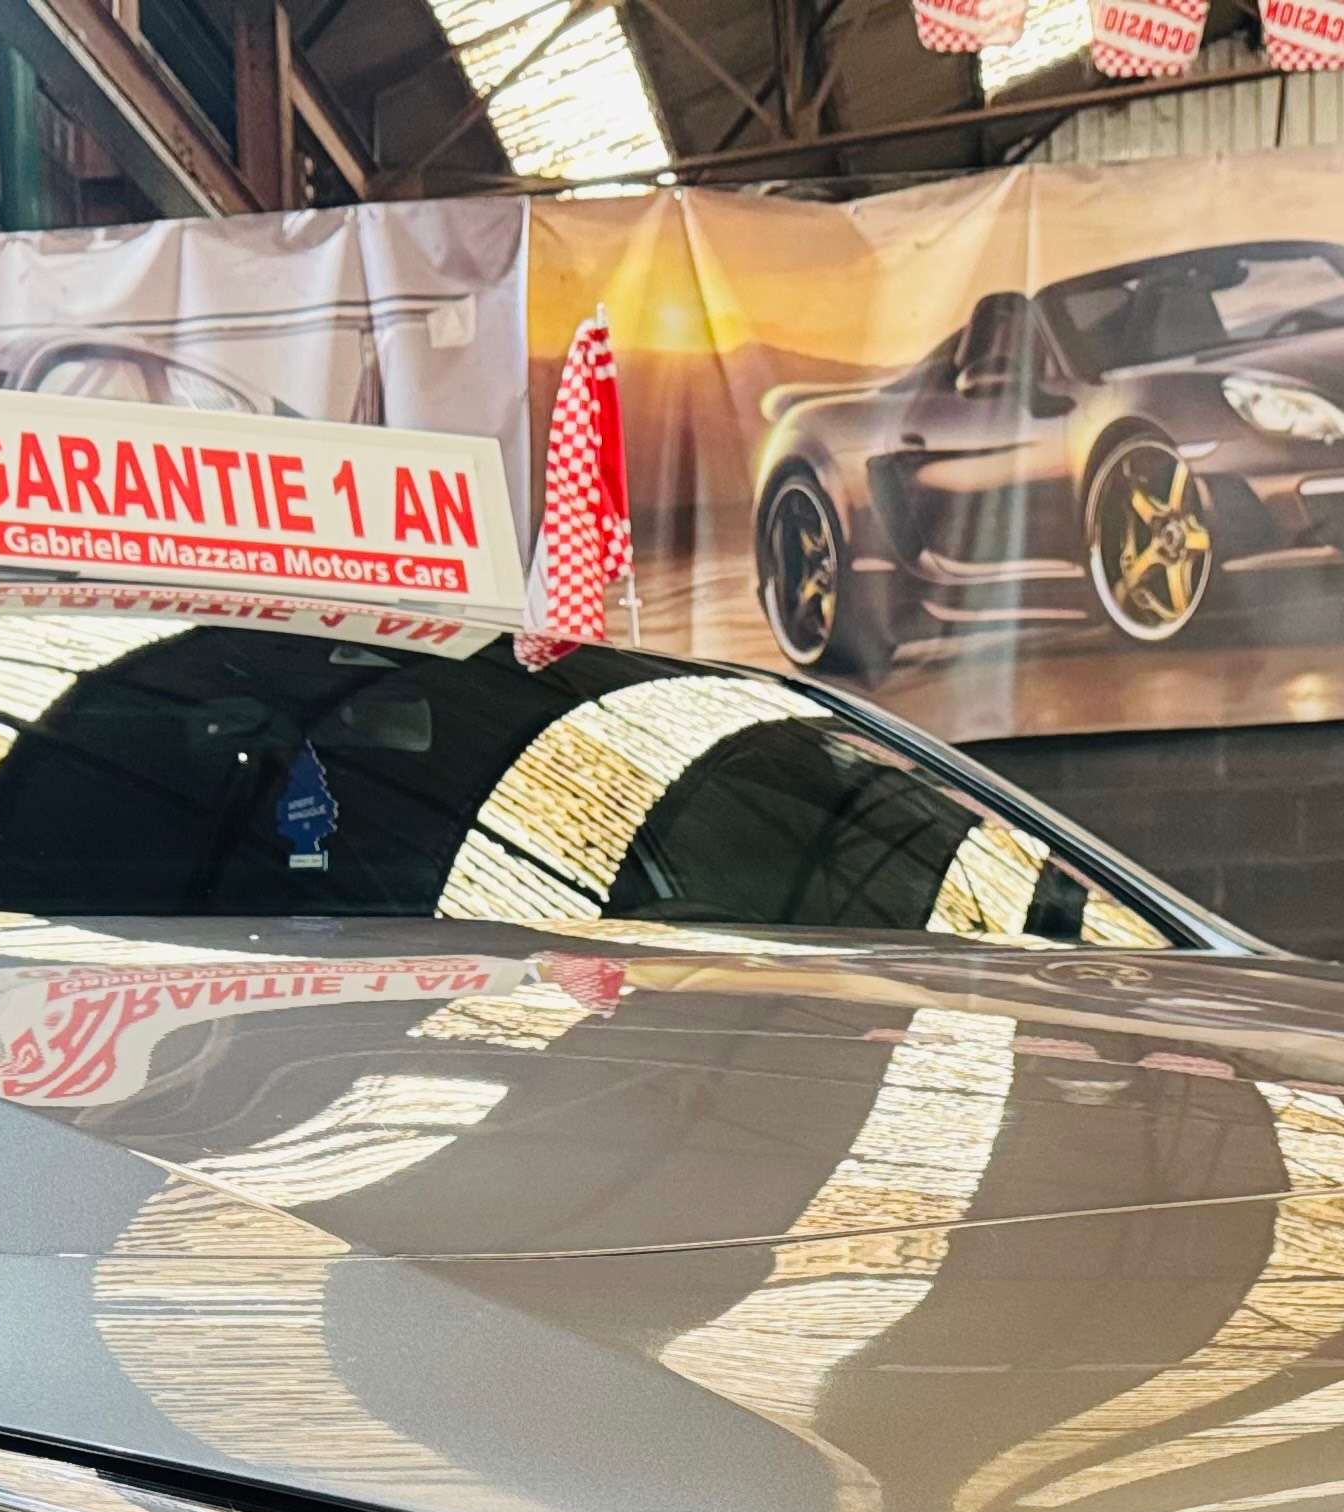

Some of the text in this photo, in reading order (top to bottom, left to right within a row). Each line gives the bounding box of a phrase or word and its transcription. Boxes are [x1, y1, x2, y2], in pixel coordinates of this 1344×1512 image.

[332, 460, 365, 538] 1
[394, 467, 479, 548] AN
[3, 525, 459, 589] Gabriele Mazzara Motors Cars
